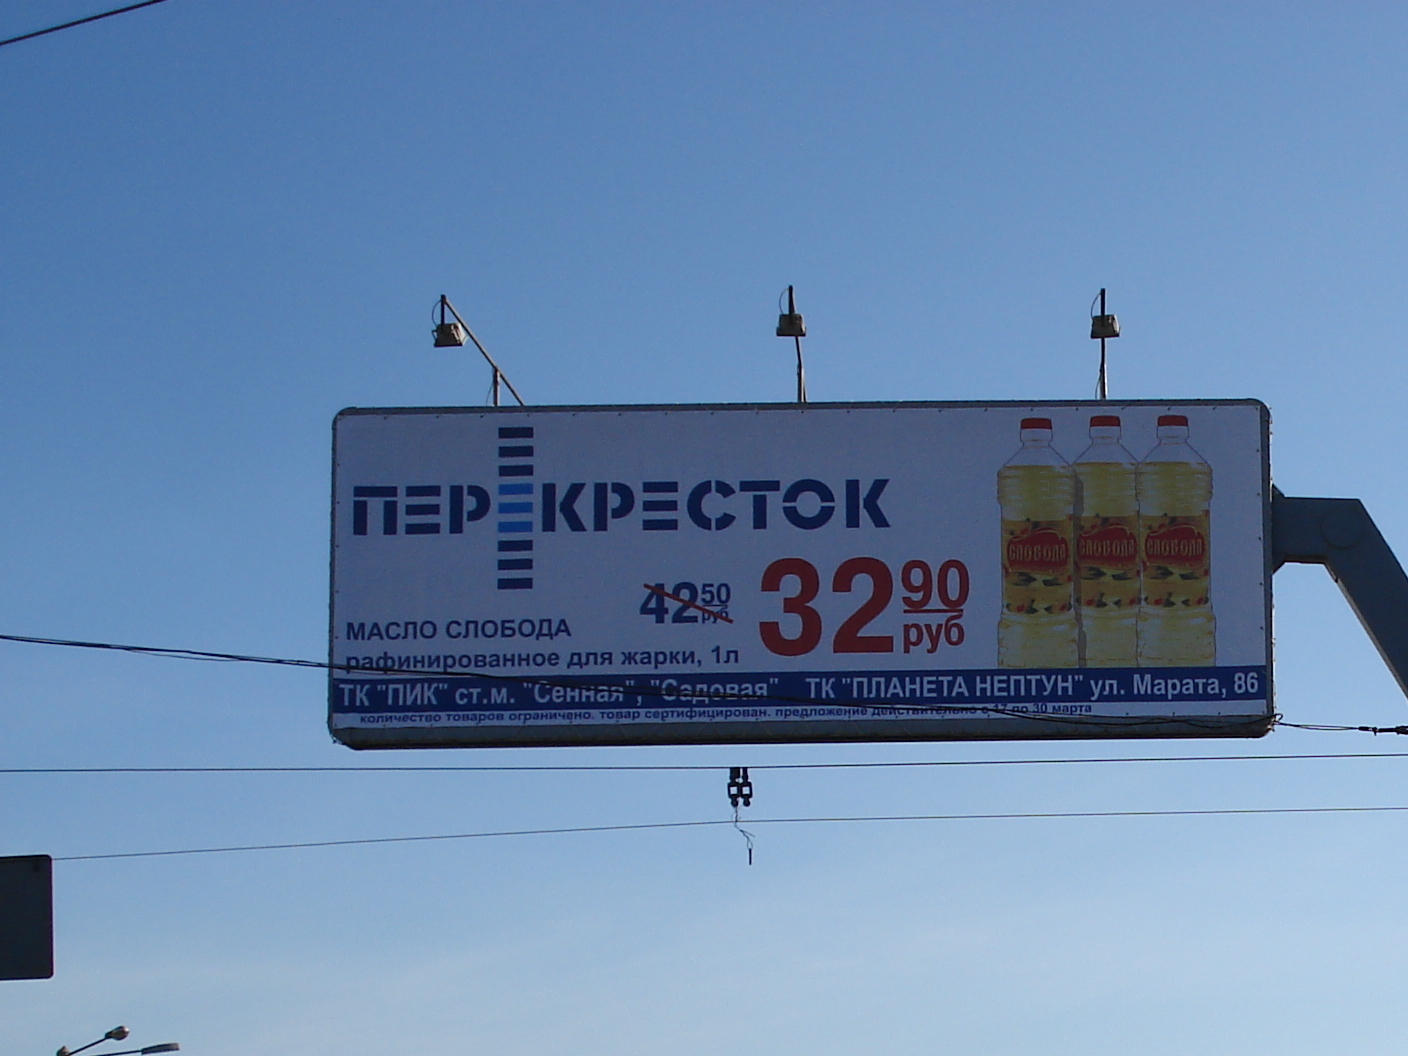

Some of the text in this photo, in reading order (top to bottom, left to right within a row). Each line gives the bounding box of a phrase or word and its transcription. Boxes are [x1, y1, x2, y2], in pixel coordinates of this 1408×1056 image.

[758, 557, 970, 657] 32 90
[345, 618, 572, 641] МАСЛО СЛОБОДА
[903, 613, 965, 654] руб
[345, 645, 740, 673] рафинированное для жарки, 1л
[339, 683, 370, 706] ТК
[377, 683, 448, 706] "ПИК"
[455, 687, 516, 705] ст.м.
[805, 671, 1260, 701] ТК "ПЛАНЕТА НЕПТУН" ул. Марата, 86
[360, 712, 442, 724] количество
[446, 711, 505, 724] товаров
[600, 708, 641, 721] товар
[775, 705, 868, 719] предложение
[1033, 703, 1047, 714] 30
[1052, 703, 1092, 715] марта
